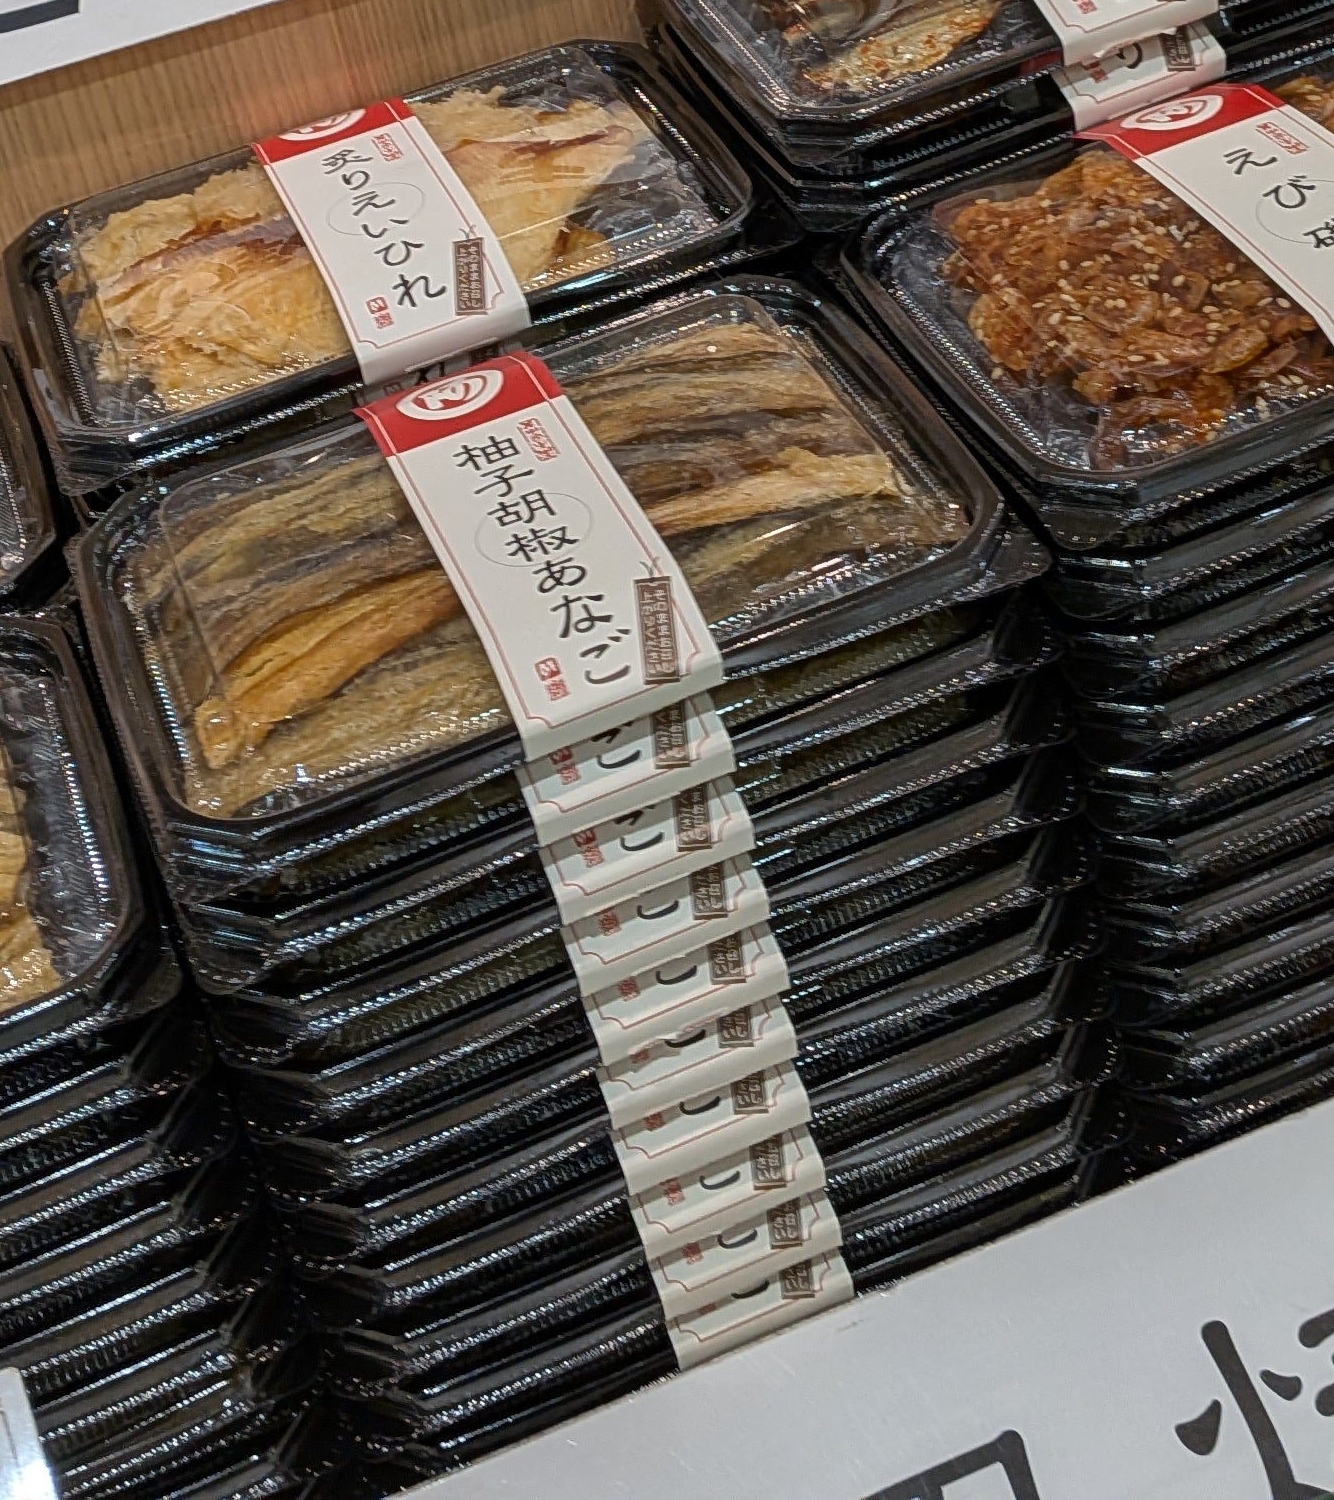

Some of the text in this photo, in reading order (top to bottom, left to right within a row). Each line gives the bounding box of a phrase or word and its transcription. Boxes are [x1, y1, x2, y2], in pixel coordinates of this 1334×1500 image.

[320, 148, 448, 309] 炙りえいひれ
[451, 435, 633, 686] 柚子胡椒あなご
